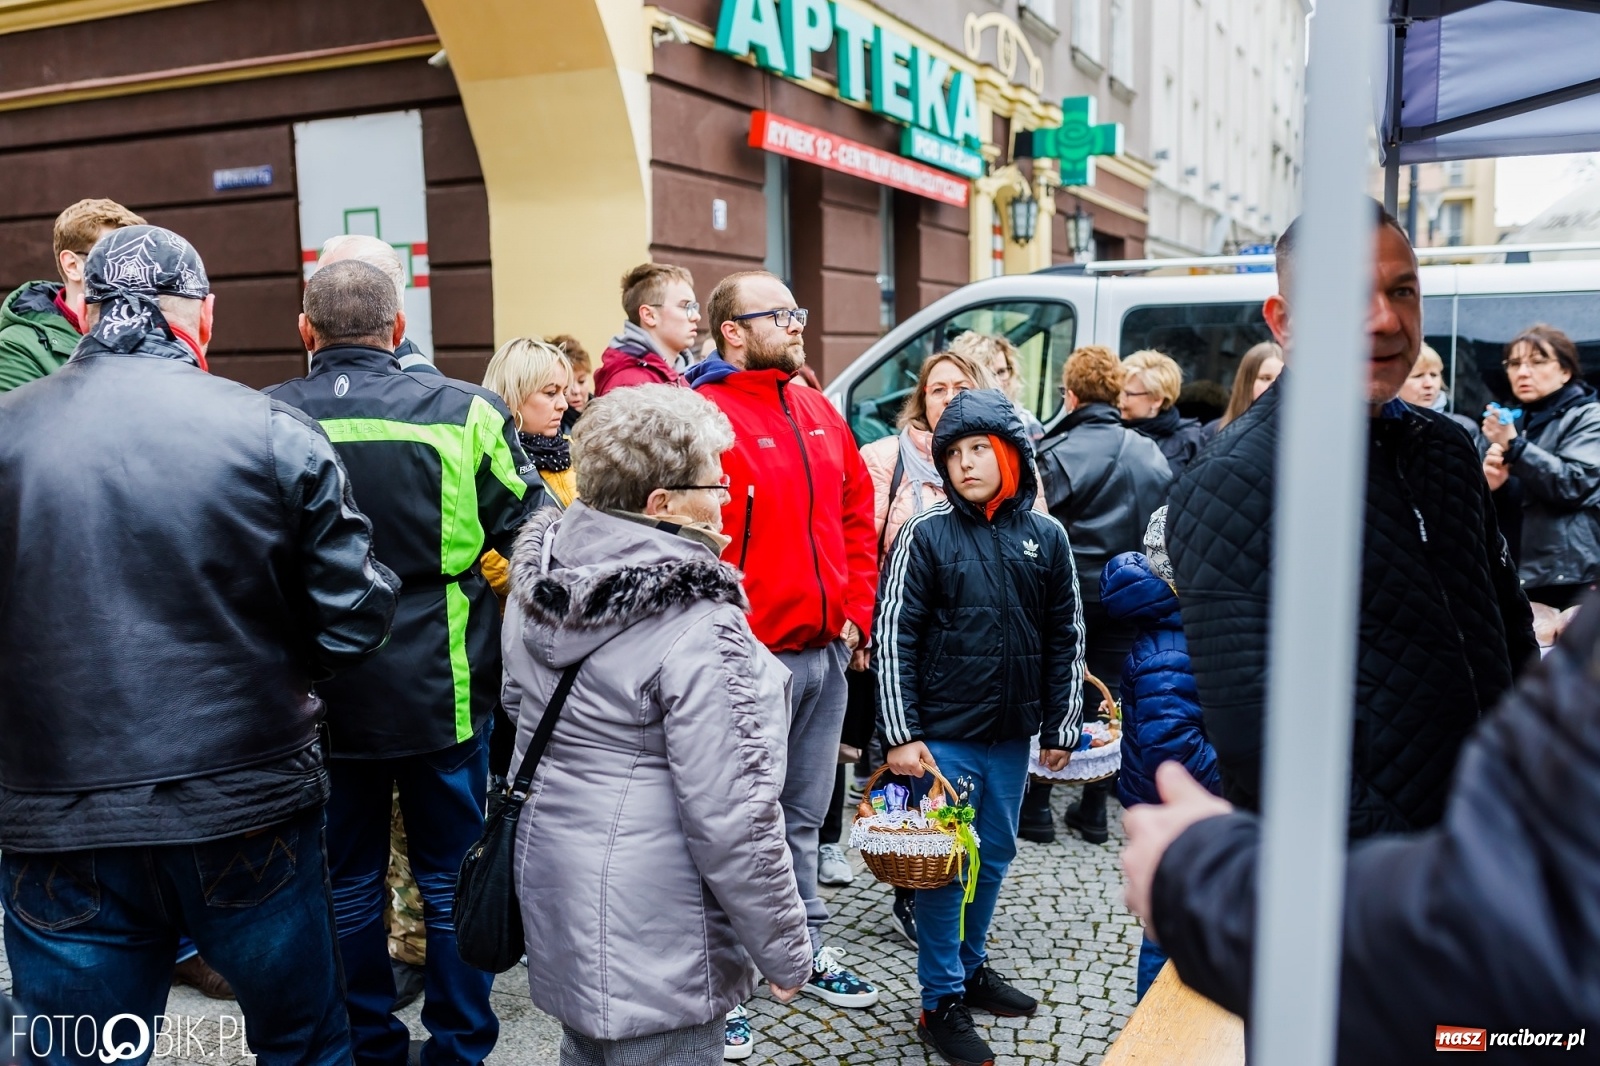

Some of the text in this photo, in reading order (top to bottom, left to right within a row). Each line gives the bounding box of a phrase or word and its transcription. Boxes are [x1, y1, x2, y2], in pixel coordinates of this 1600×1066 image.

[715, 0, 981, 146] APTEKA
[767, 121, 815, 156] RYNEK
[815, 136, 832, 161] 12
